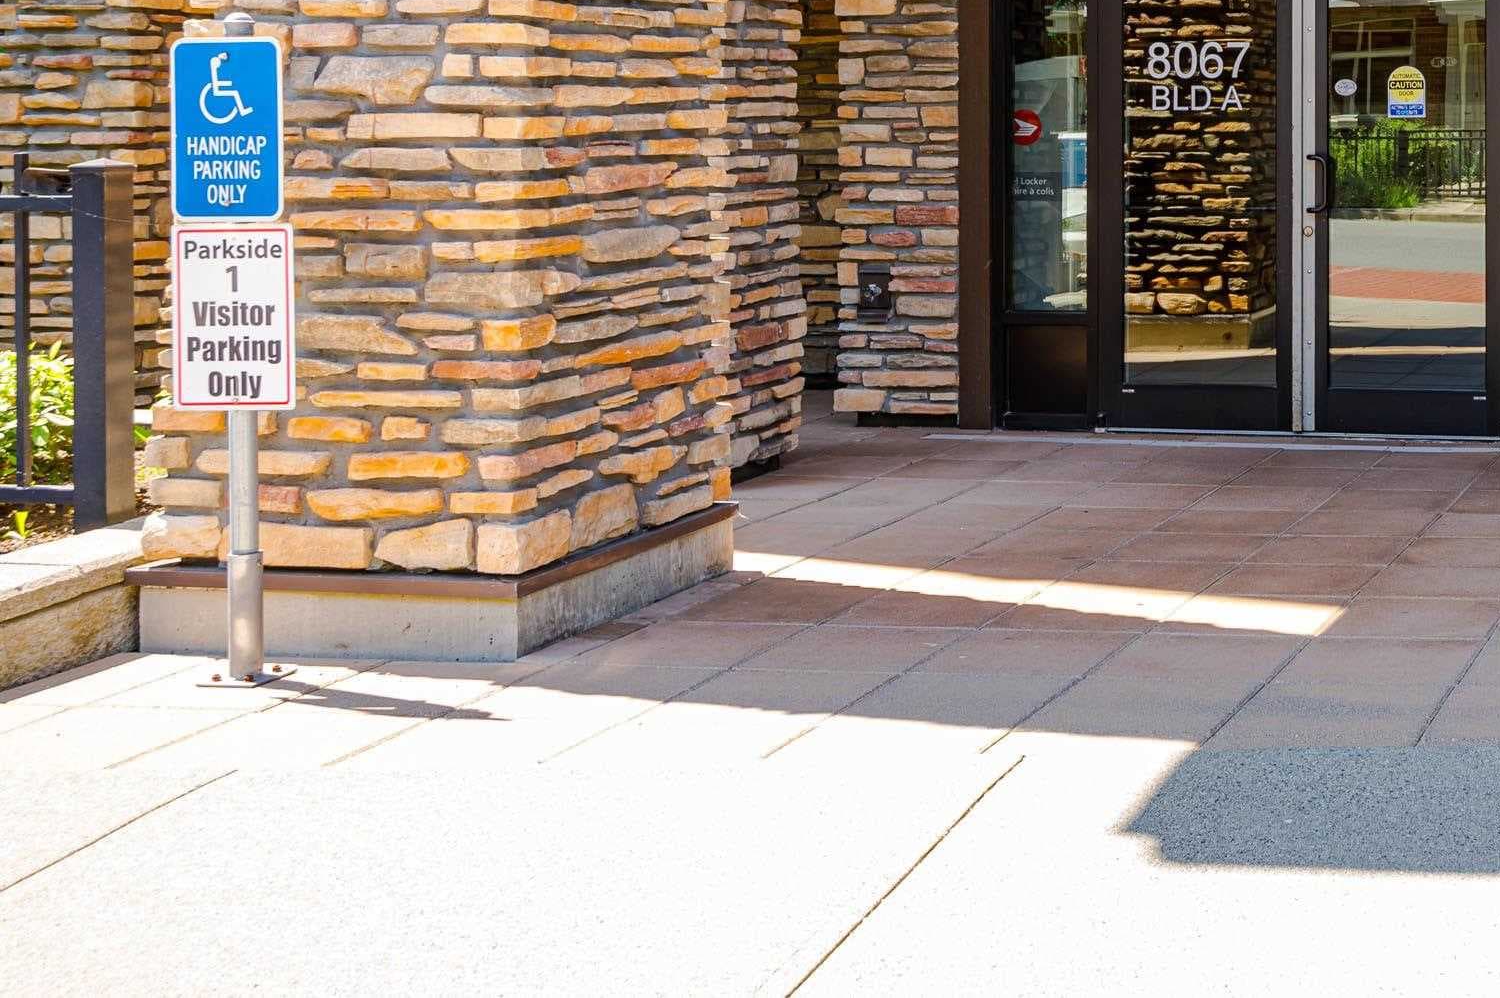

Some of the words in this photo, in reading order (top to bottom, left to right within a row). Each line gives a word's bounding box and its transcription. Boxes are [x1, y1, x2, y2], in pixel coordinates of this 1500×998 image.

[1147, 41, 1251, 80] 8067
[1390, 81, 1423, 89] CAUTION
[1151, 85, 1212, 111] BLD
[1220, 85, 1243, 111] A
[186, 135, 267, 156] HANDICAP
[193, 160, 261, 180] PARKING
[1020, 177, 1047, 185] Locker
[206, 184, 248, 205] ONLY
[183, 238, 283, 259] Parkside
[225, 265, 238, 292] 1
[192, 301, 275, 326] Visitor
[187, 336, 282, 364] Parking
[208, 371, 262, 399] Only
